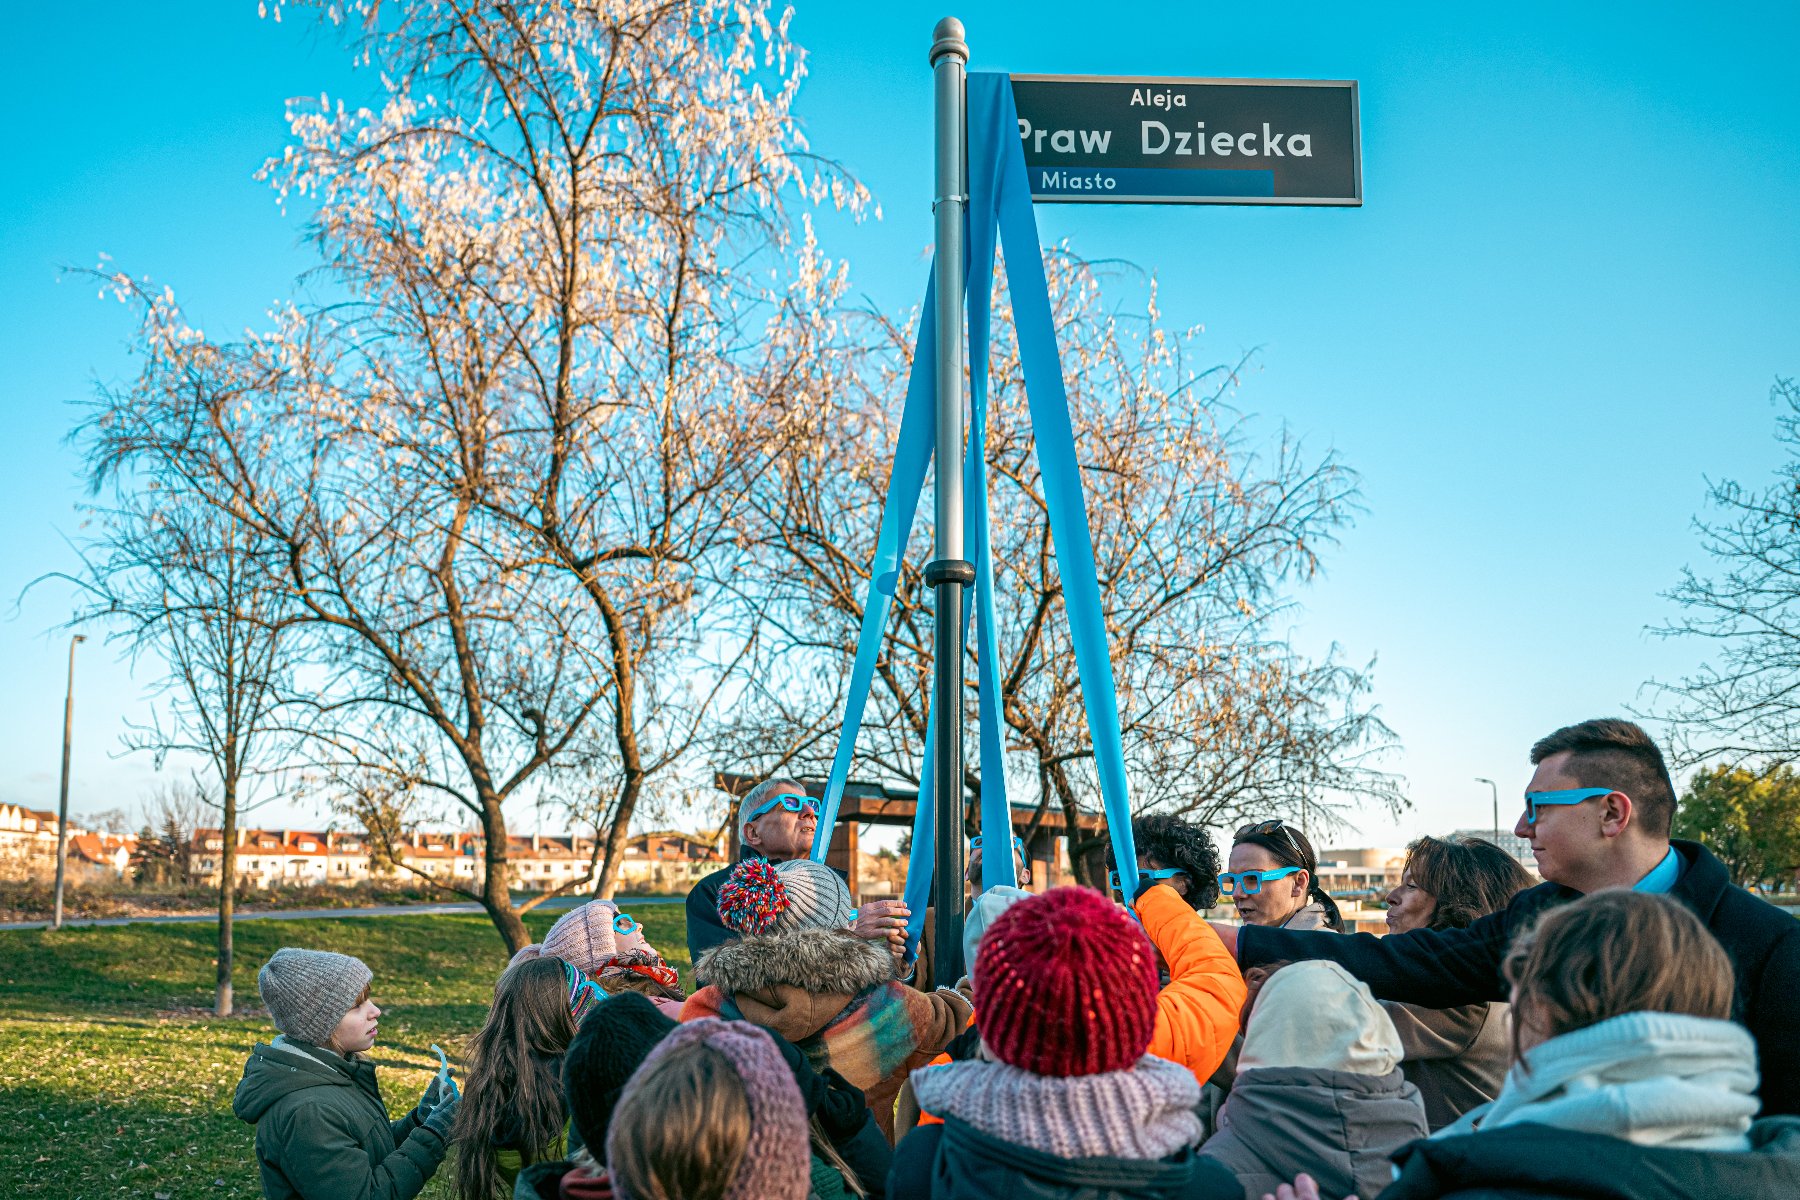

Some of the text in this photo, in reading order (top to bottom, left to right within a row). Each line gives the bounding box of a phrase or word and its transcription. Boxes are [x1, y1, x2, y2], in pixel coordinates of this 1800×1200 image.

[1130, 88, 1187, 112] Aleja
[1141, 120, 1313, 157] Dziecka
[1042, 171, 1116, 190] Miasto
